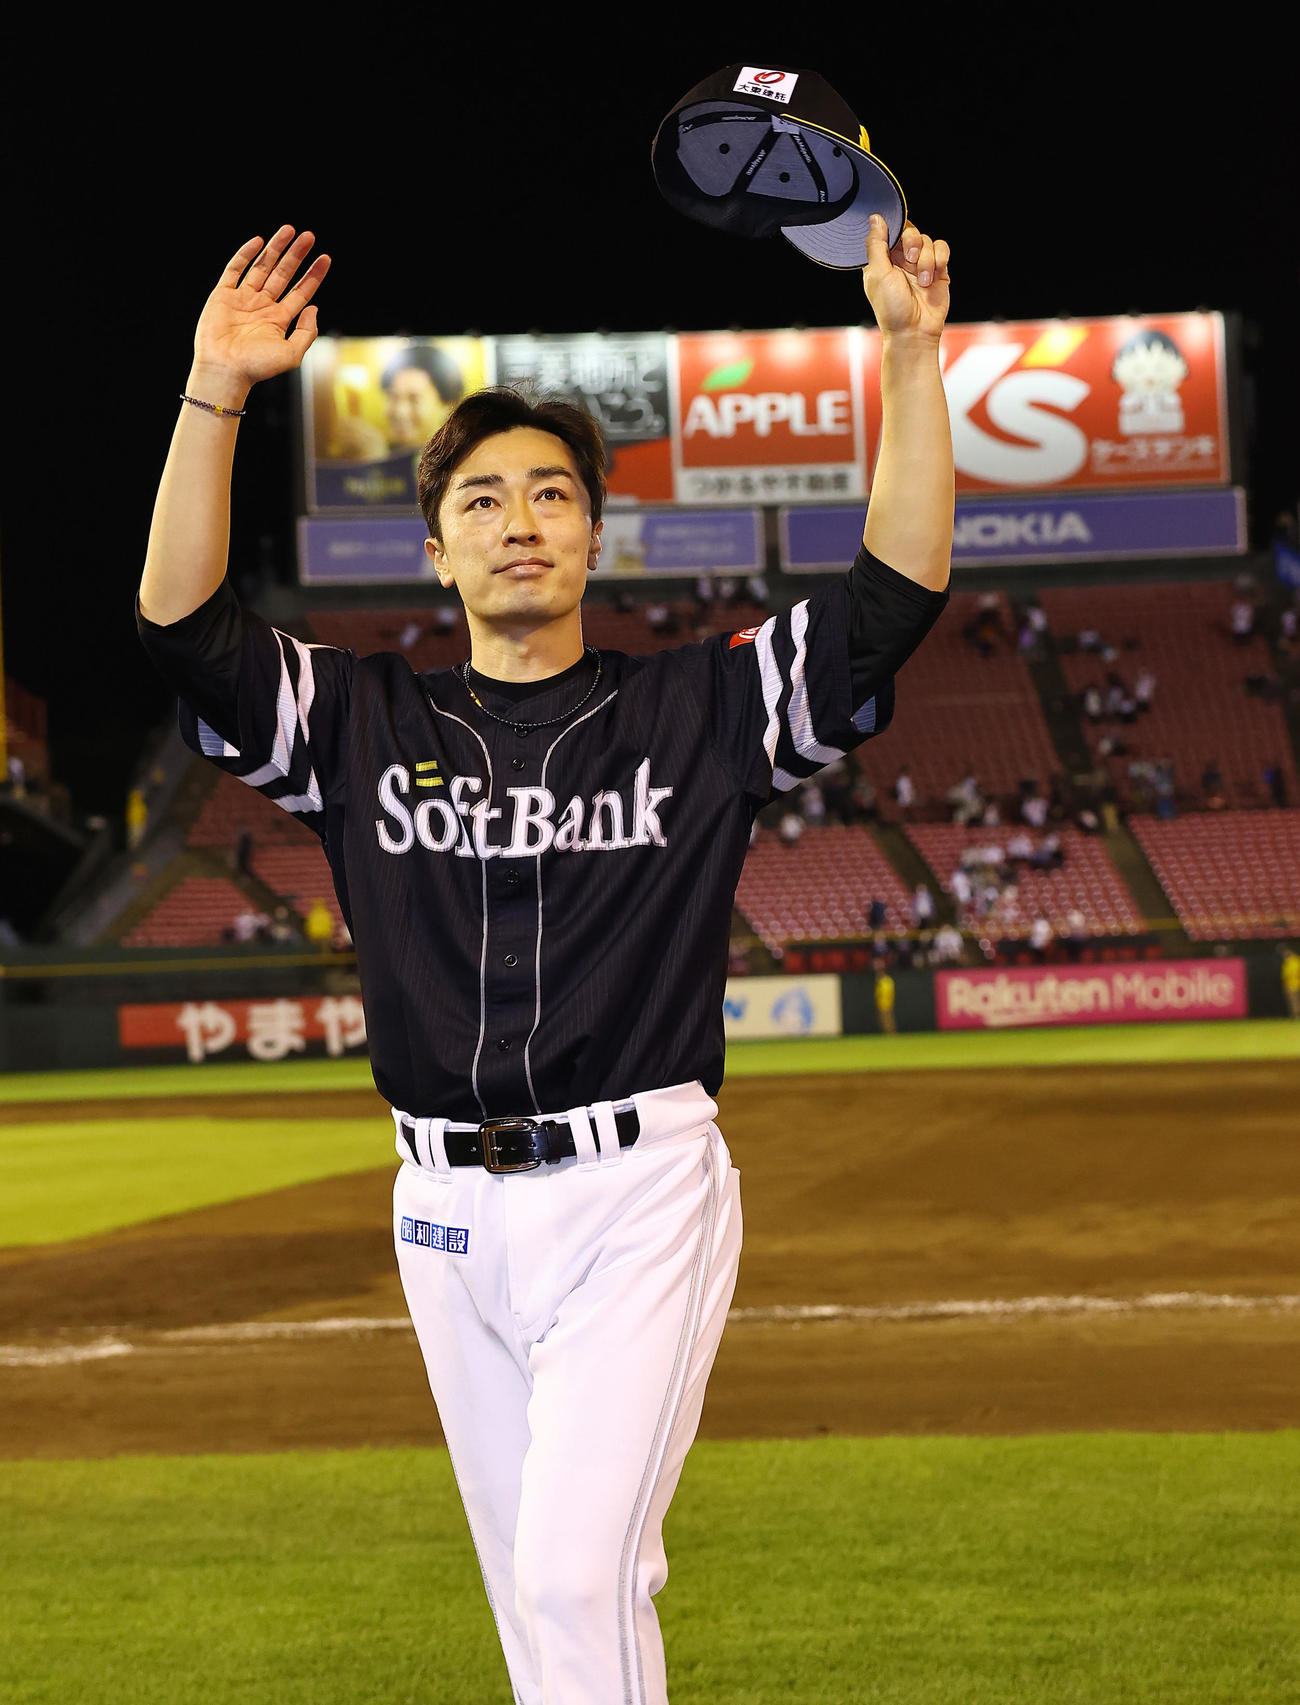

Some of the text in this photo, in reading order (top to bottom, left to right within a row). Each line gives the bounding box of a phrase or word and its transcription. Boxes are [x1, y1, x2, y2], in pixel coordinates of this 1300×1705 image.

[737, 83, 787, 101] 大東建託
[683, 390, 850, 439] APPLE
[375, 757, 674, 860] SoftBank
[947, 967, 1235, 1019] Rakuten Mobile
[175, 997, 368, 1063] やまや
[402, 1218, 467, 1252] 昭和建設
